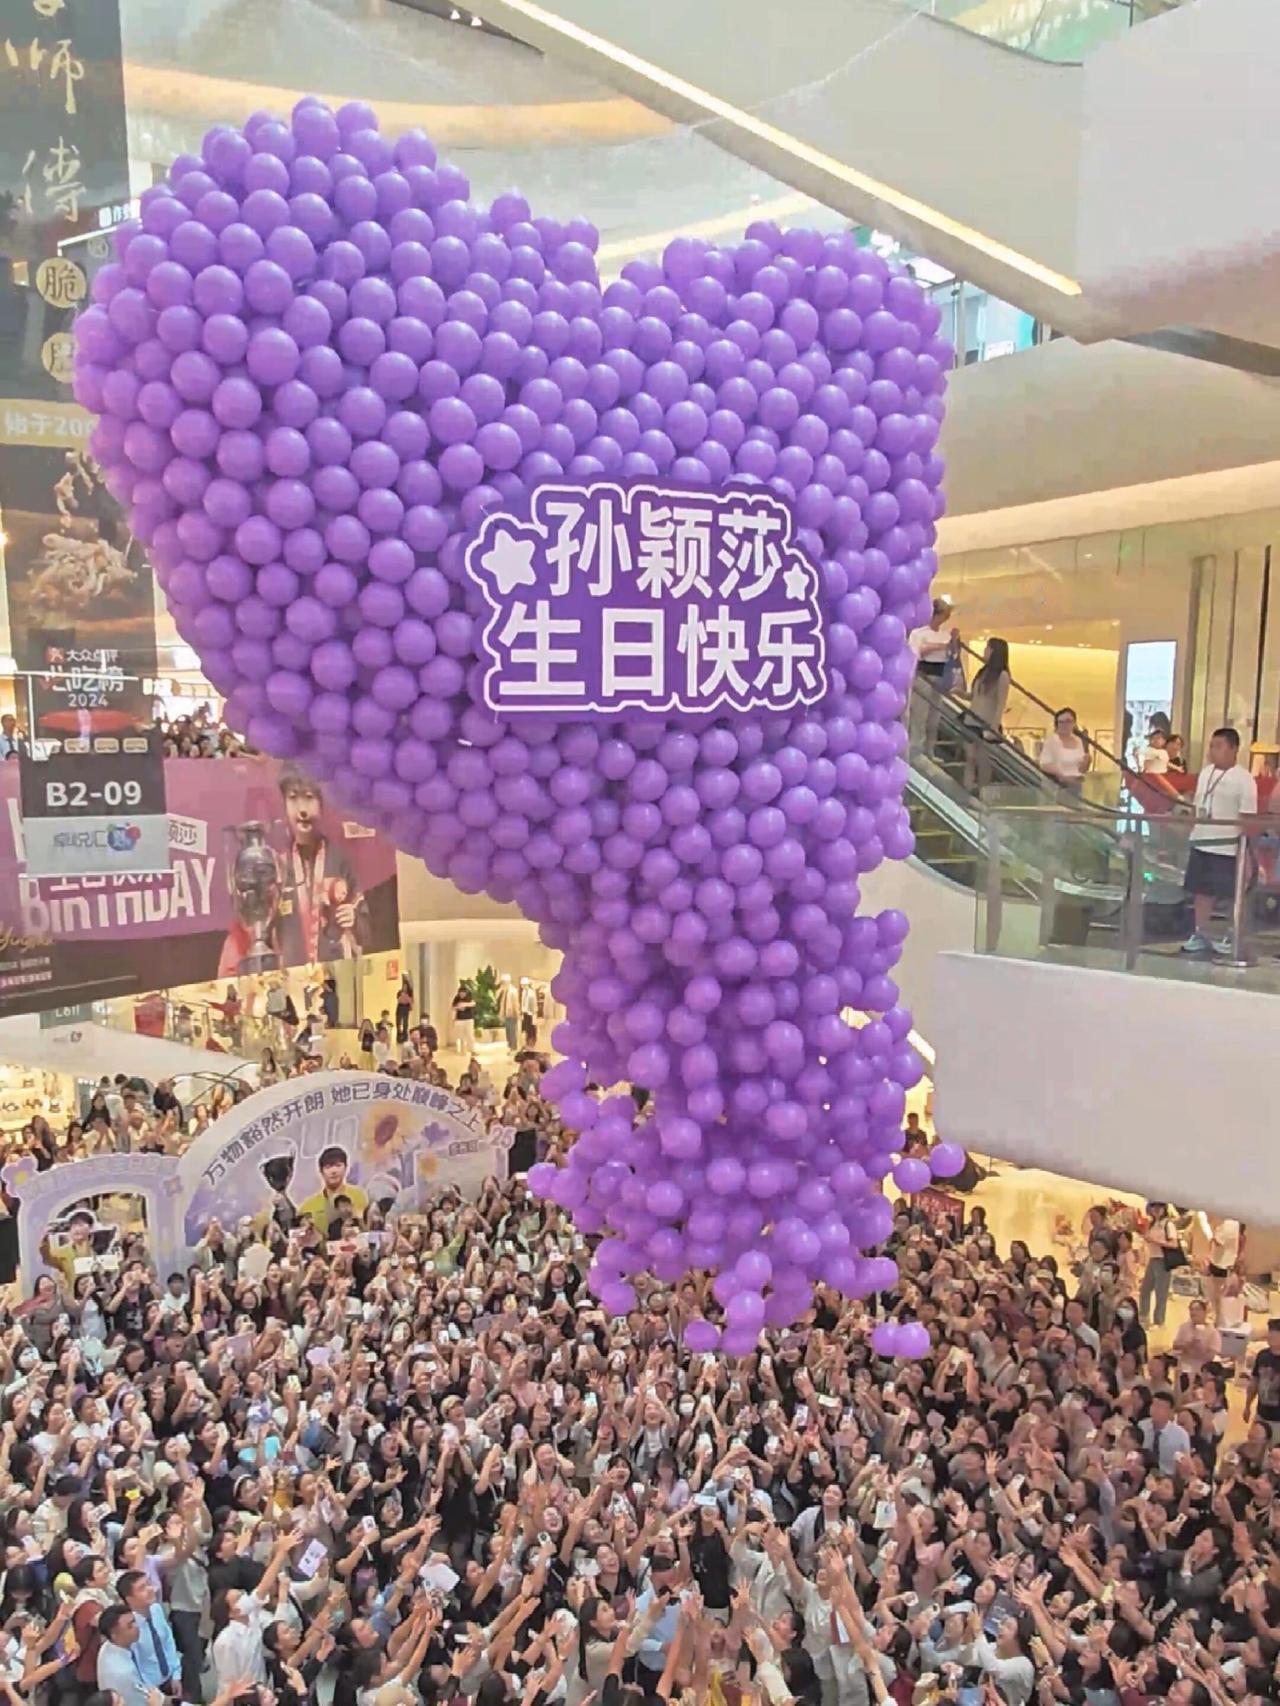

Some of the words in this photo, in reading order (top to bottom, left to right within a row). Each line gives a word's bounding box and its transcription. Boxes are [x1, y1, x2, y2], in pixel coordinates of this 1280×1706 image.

[545, 499, 782, 601] 孙颖莎
[499, 600, 816, 697] 生日快乐
[68, 693, 108, 707] 2024
[46, 781, 142, 806] B2-09
[202, 1091, 324, 1185] 万物豁然开朗
[331, 1081, 480, 1132] 她已身处巅峰之上
